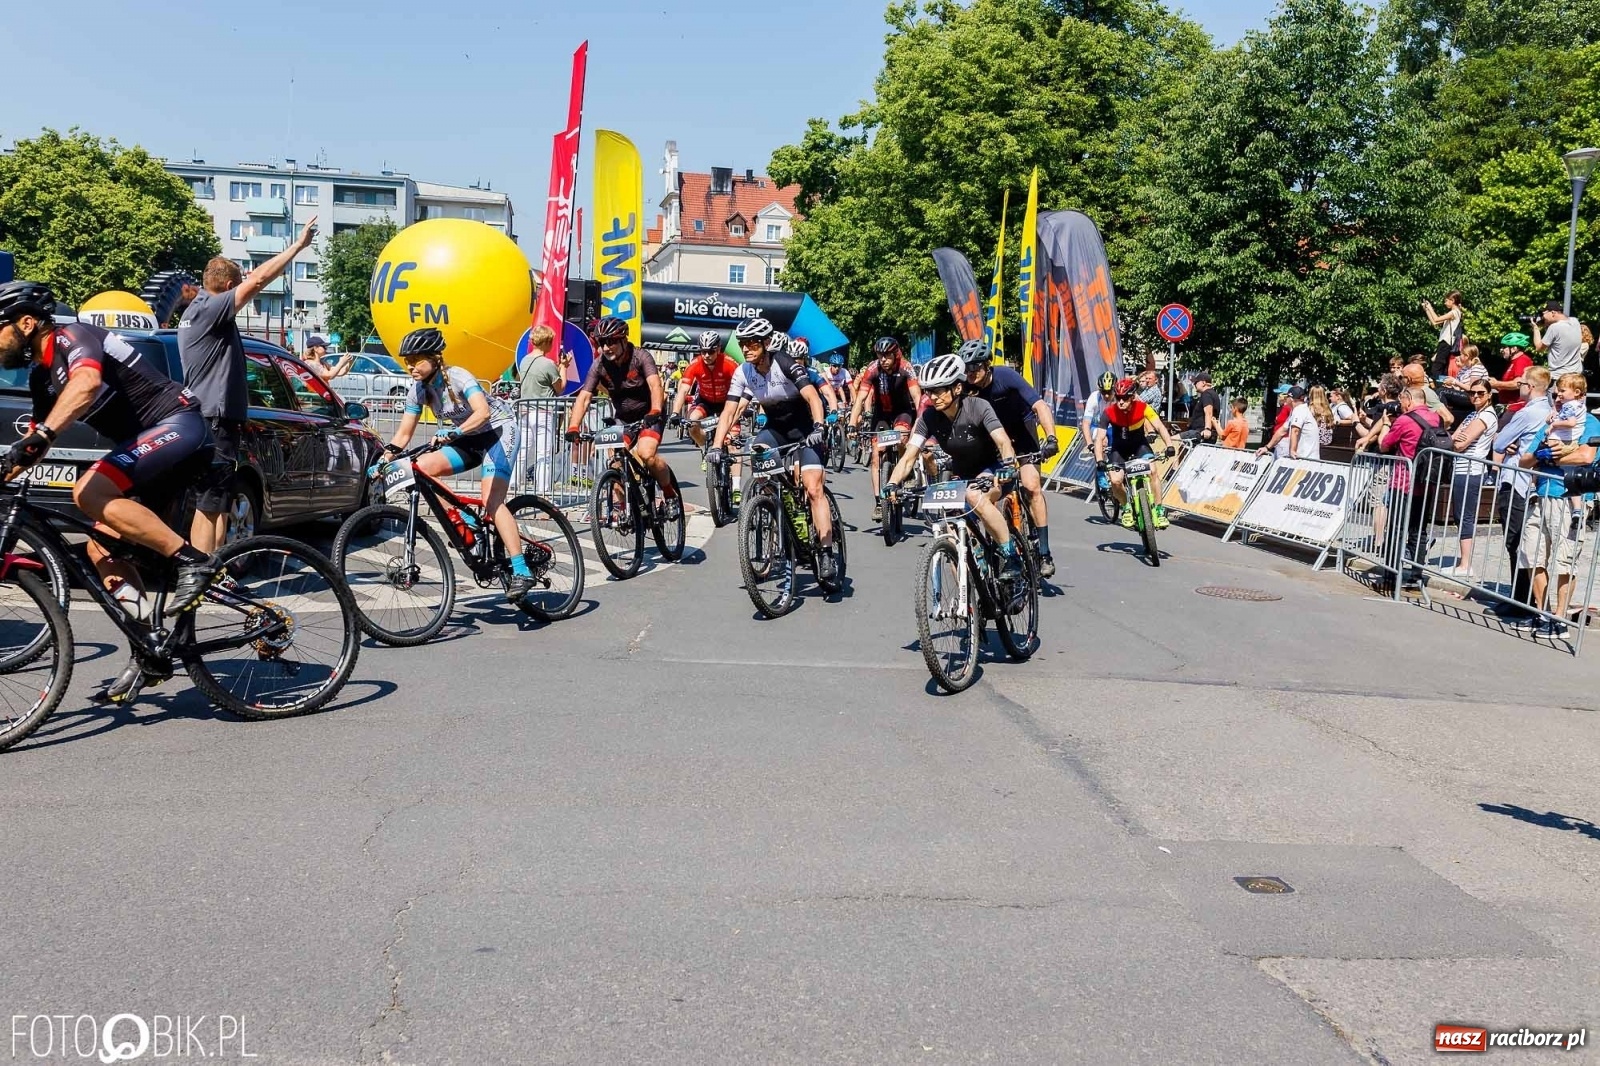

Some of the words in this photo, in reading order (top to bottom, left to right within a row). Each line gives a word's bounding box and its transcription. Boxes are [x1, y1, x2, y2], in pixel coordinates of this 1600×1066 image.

[370, 262, 417, 303] MF
[409, 303, 449, 325] FM
[674, 298, 708, 316] bike
[712, 302, 763, 319] atelier
[642, 341, 701, 351] MERID
[600, 433, 618, 442] 1910
[385, 469, 406, 486] 1009
[1266, 466, 1333, 502] TAURUS
[932, 490, 957, 500] 1933
